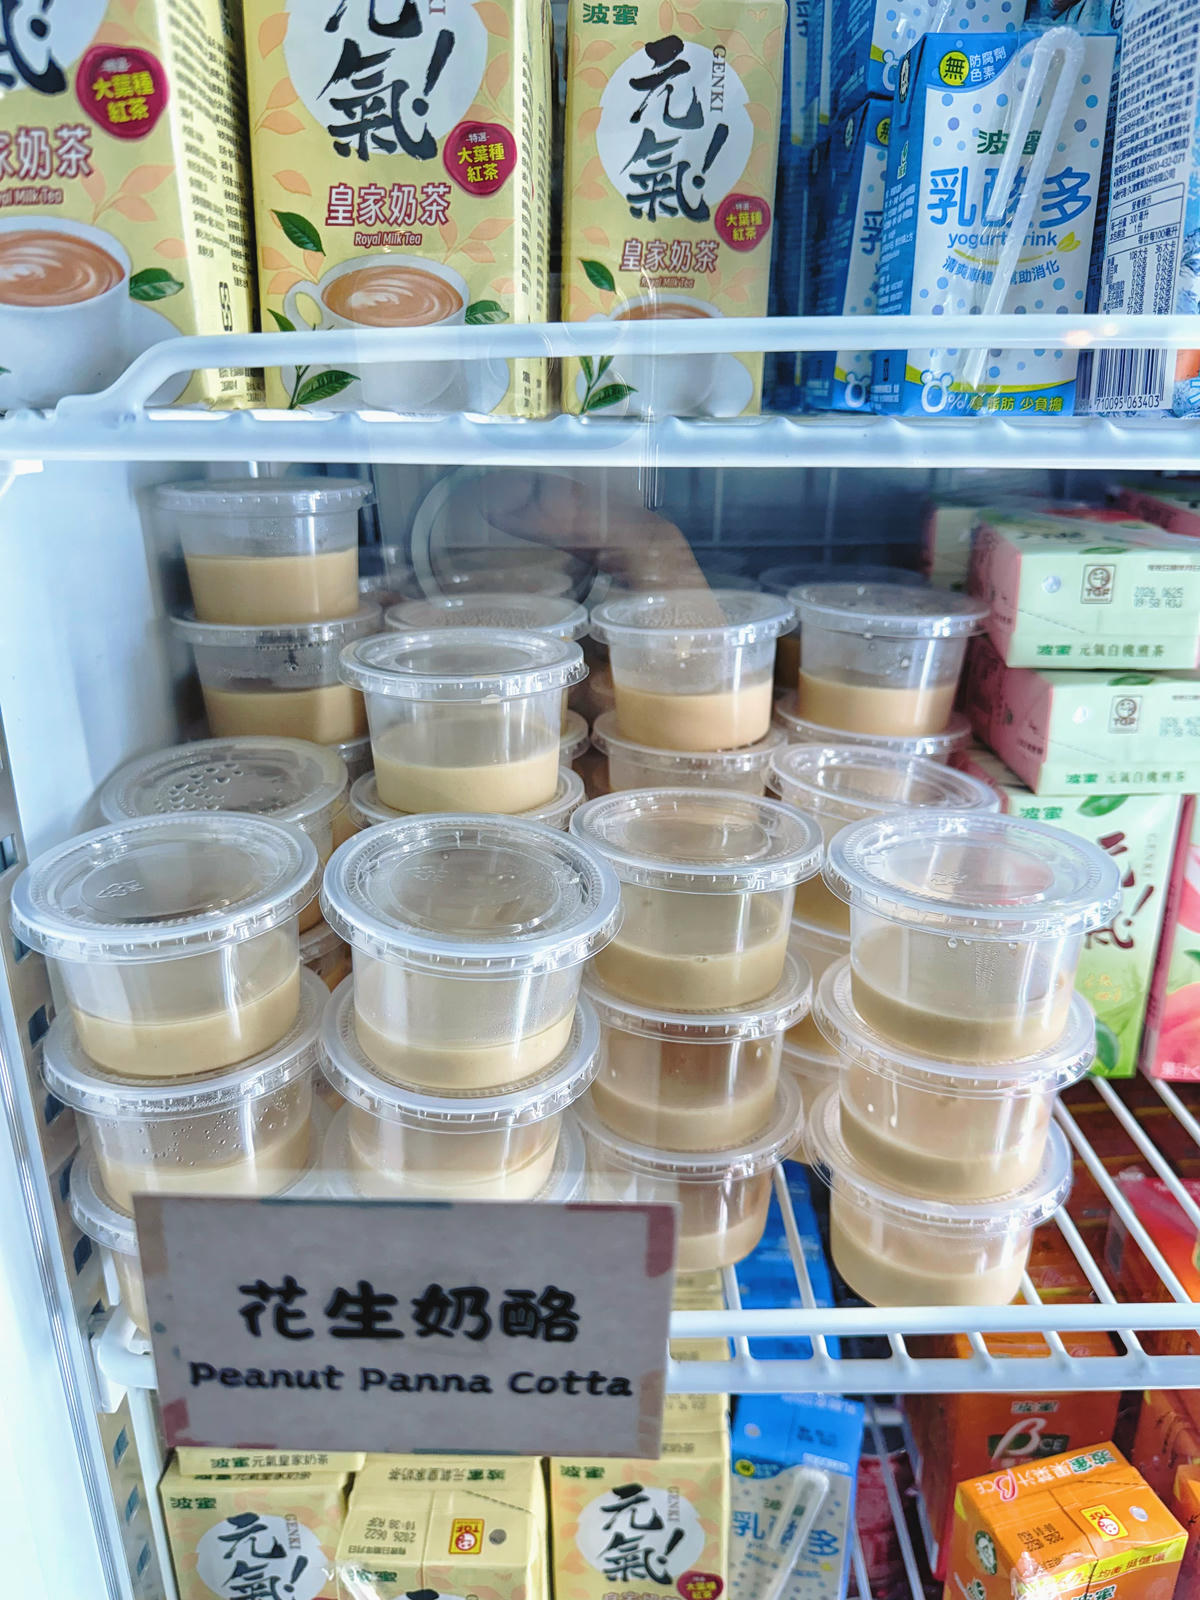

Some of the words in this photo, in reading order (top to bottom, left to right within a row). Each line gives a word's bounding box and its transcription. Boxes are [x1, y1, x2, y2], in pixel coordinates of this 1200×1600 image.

[582, 2, 639, 26] 波蜜
[969, 45, 1007, 68] 防腐劑
[710, 43, 727, 114] GENKI
[943, 56, 966, 81] 無
[970, 64, 996, 82] 色素
[457, 142, 506, 165] 大葉種
[466, 162, 500, 184] 紅茶
[325, 182, 451, 227] 皇家奶茶
[354, 231, 382, 247] Royal
[382, 231, 402, 246] Milk
[403, 231, 422, 247] Tea
[732, 226, 757, 242] 紅茶
[947, 232, 1008, 249] yogurt
[1022, 230, 1057, 247] rink
[618, 238, 721, 274] 皇家奶茶
[1127, 394, 1161, 410] 063403
[238, 1275, 580, 1343] 花生奶酪
[188, 1361, 343, 1392] Peanut
[360, 1367, 493, 1395] Panna
[509, 1370, 633, 1398] Cotta
